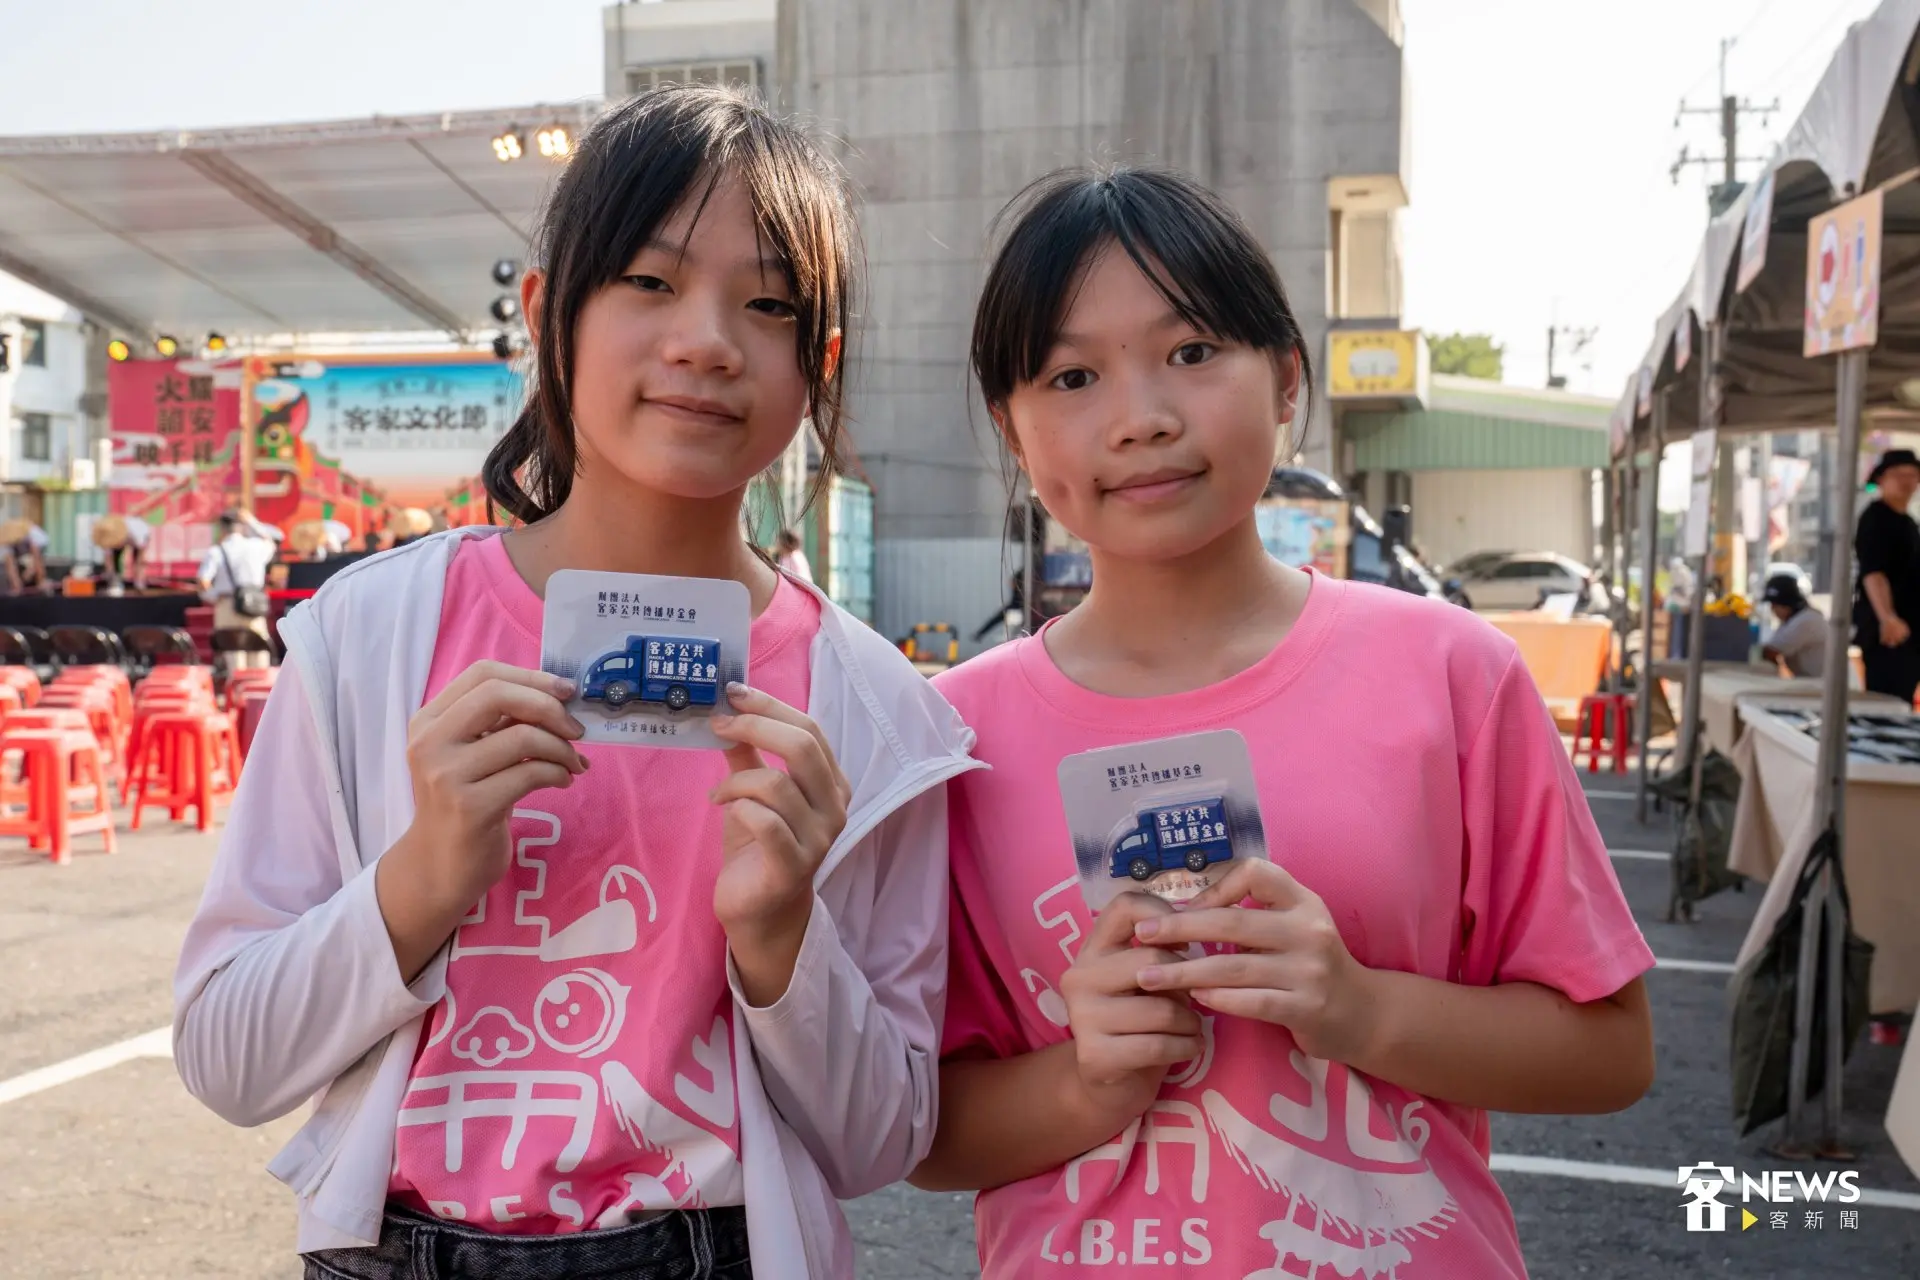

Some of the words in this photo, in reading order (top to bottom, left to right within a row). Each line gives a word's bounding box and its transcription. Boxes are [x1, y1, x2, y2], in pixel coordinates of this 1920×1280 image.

[343, 404, 489, 432] 客家文化節
[598, 591, 641, 604] 財團法人
[597, 602, 697, 620] 客家公共傳播基金會
[649, 641, 705, 658] 客家公共
[648, 660, 717, 678] 傳播基金會
[1107, 762, 1148, 777] 財團法人
[1109, 764, 1202, 788] 客家公共傳播基金會
[1157, 806, 1210, 827] 客家公共
[1161, 822, 1225, 844] 傳播基金會
